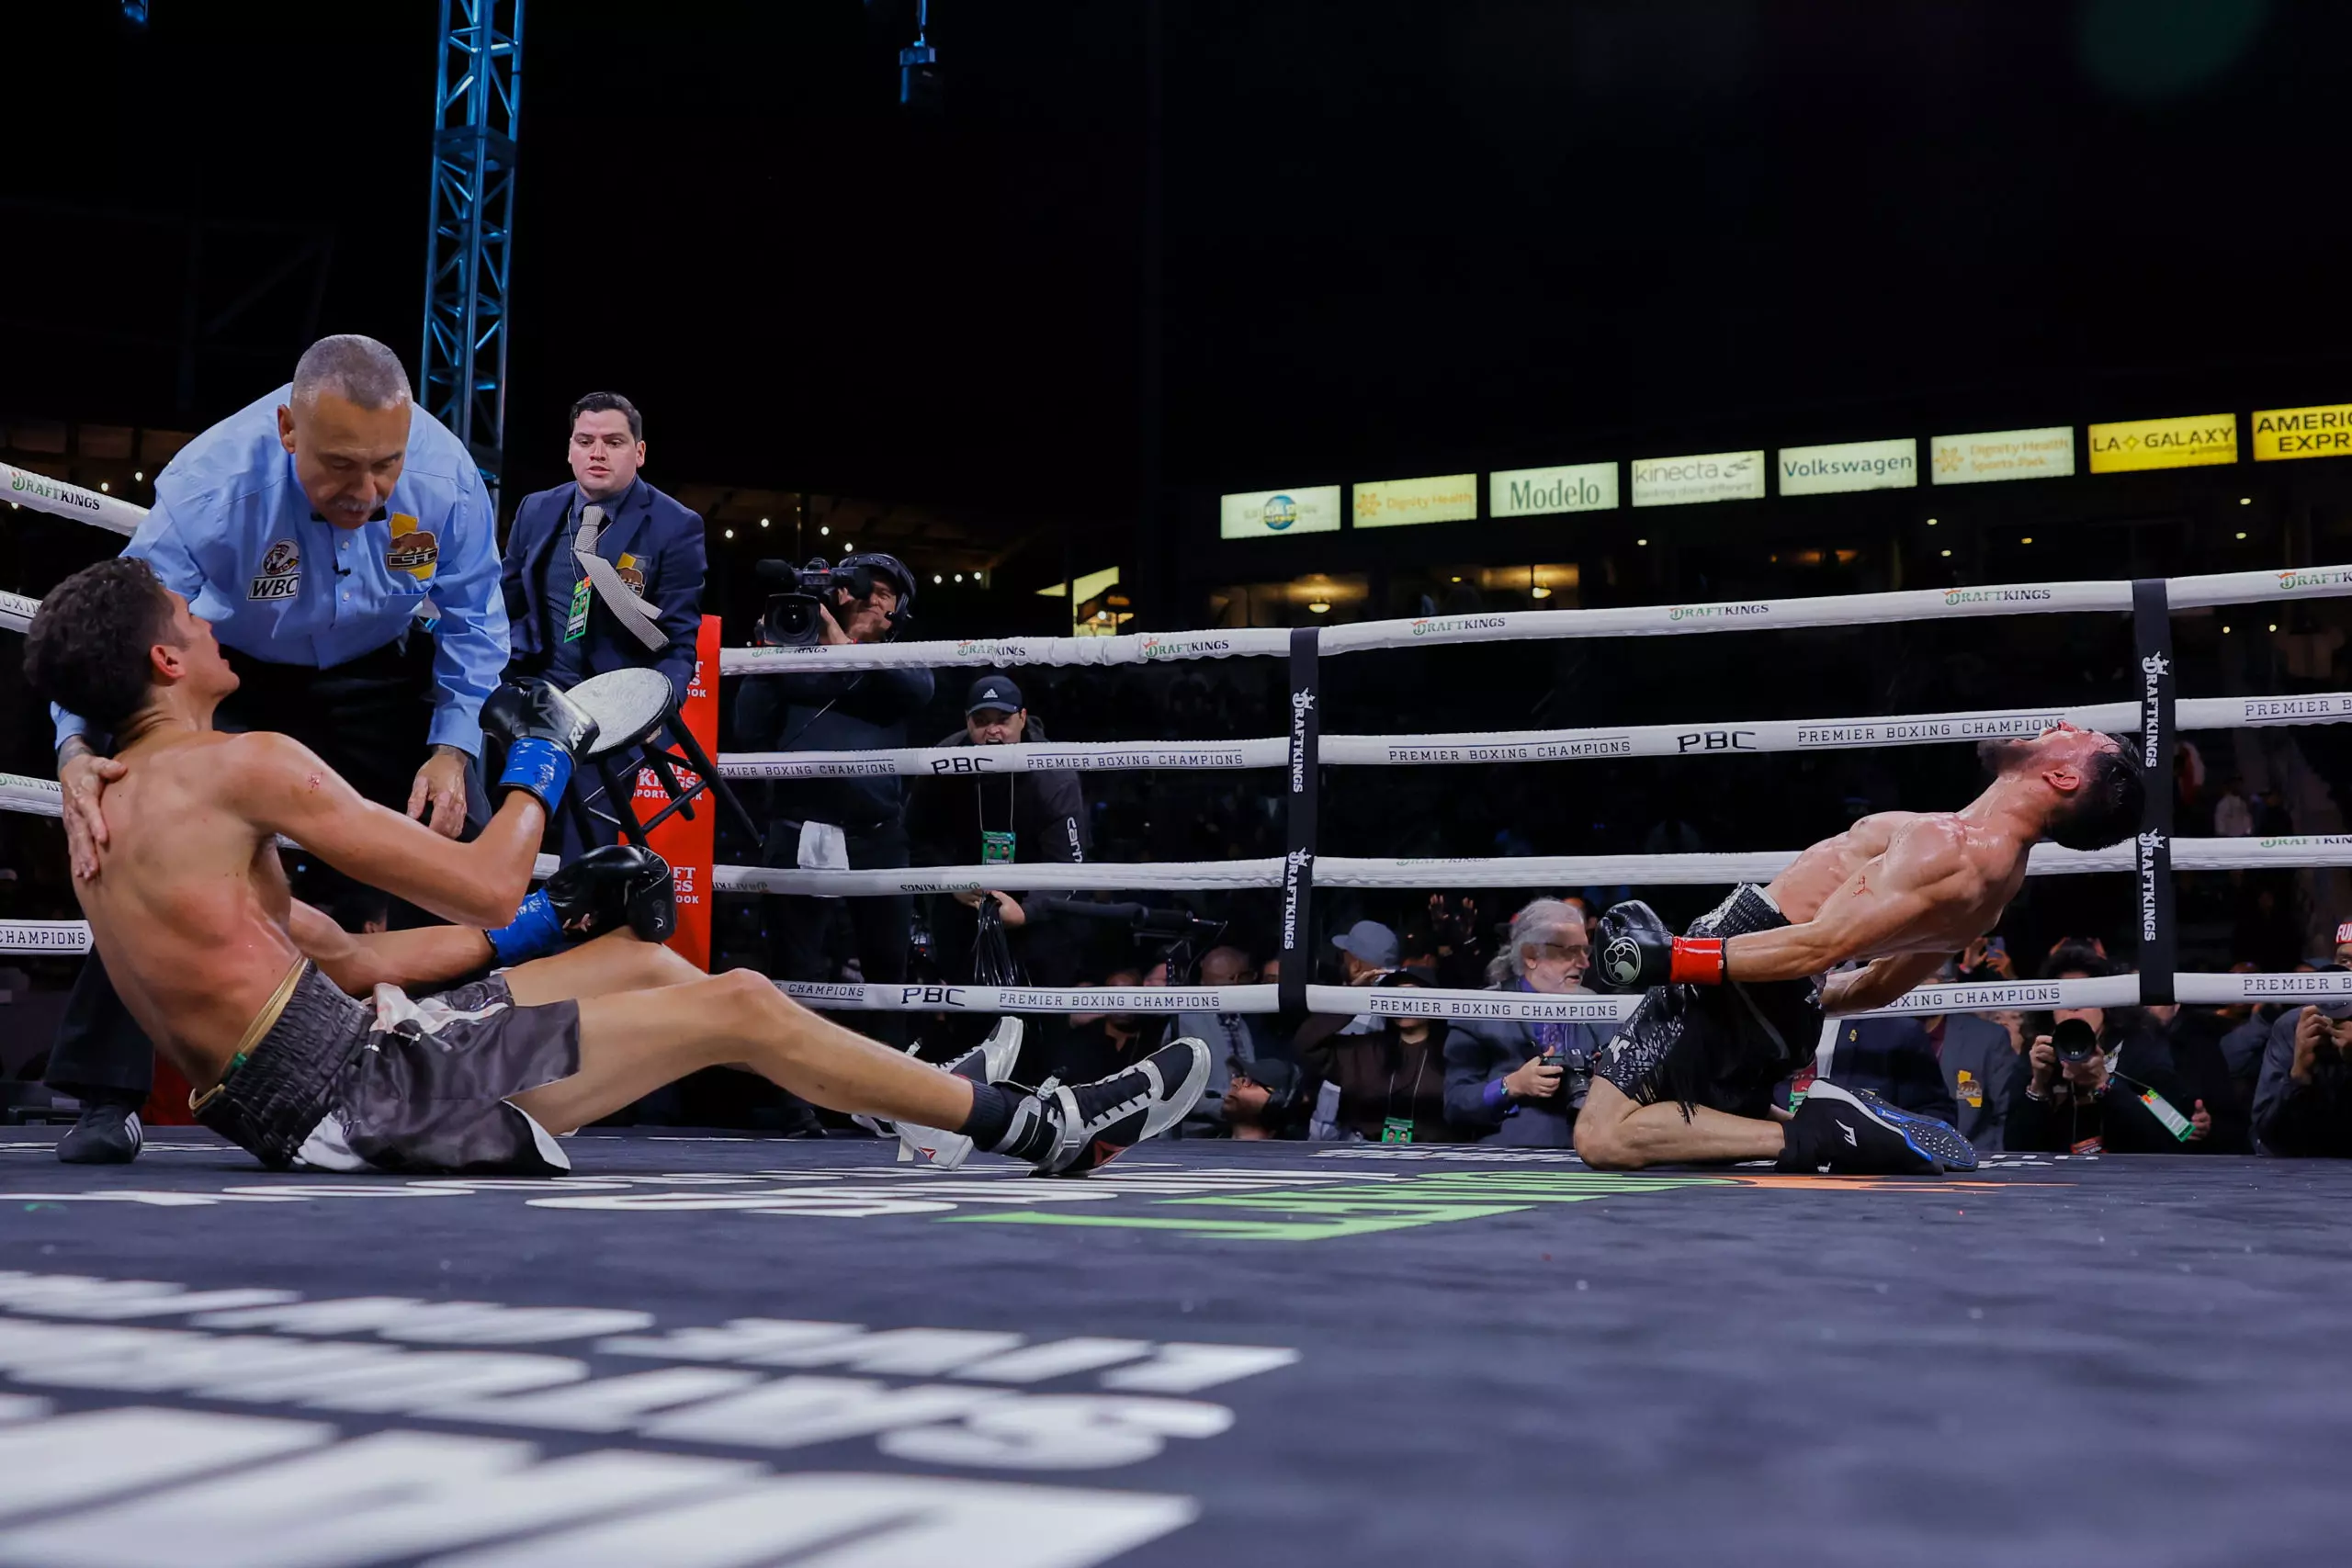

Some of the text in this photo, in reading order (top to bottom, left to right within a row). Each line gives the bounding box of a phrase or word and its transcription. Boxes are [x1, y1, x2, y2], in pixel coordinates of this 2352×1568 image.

[2257, 411, 2352, 434] AMERI
[2093, 426, 2233, 453] LA GALAXY
[1635, 461, 1719, 484] kinecta
[1783, 456, 1913, 477] Volkswagen
[12, 474, 100, 511] DRAFTKINGS
[1510, 477, 1600, 510] Modelo
[253, 577, 299, 597] WBC
[1945, 589, 2051, 606] DRAFTKINGS
[1669, 604, 1769, 621] DRAFTKINGS
[1412, 618, 1506, 636] DRAFTKINGS
[1146, 640, 1229, 659] DRAFTKINGS
[2142, 656, 2159, 768] DRAFTKINGS
[2245, 700, 2330, 716] PREMIER
[1292, 692, 1306, 793] DRAFTKINGS
[1678, 730, 1757, 753] PBC
[1798, 728, 1875, 743] PREMIER
[1886, 723, 1951, 739] BOXING
[1389, 741, 1631, 761] PREMIER BOXING CHAMPIONS
[765, 765, 812, 776] BOXING
[820, 763, 896, 774] CHAMPIONS
[931, 757, 993, 775] PBC
[1027, 754, 1243, 769] PREMIER BOXING CHAMPIONS
[2138, 831, 2156, 942] DRAFTKINGS
[1284, 851, 1299, 950] DRAFTKINGS
[0, 931, 85, 944] HAMPIONS
[788, 983, 865, 997] CHAMPIONS
[2244, 977, 2330, 990] PREMIER
[901, 987, 966, 1007] PBC
[1000, 993, 1220, 1007] PREMIER BOXING CHAMPIONS
[1889, 987, 2060, 1008] OXING CHAMPIONS
[1370, 999, 1618, 1017] PREMIER BOXING CHAMPIONS
